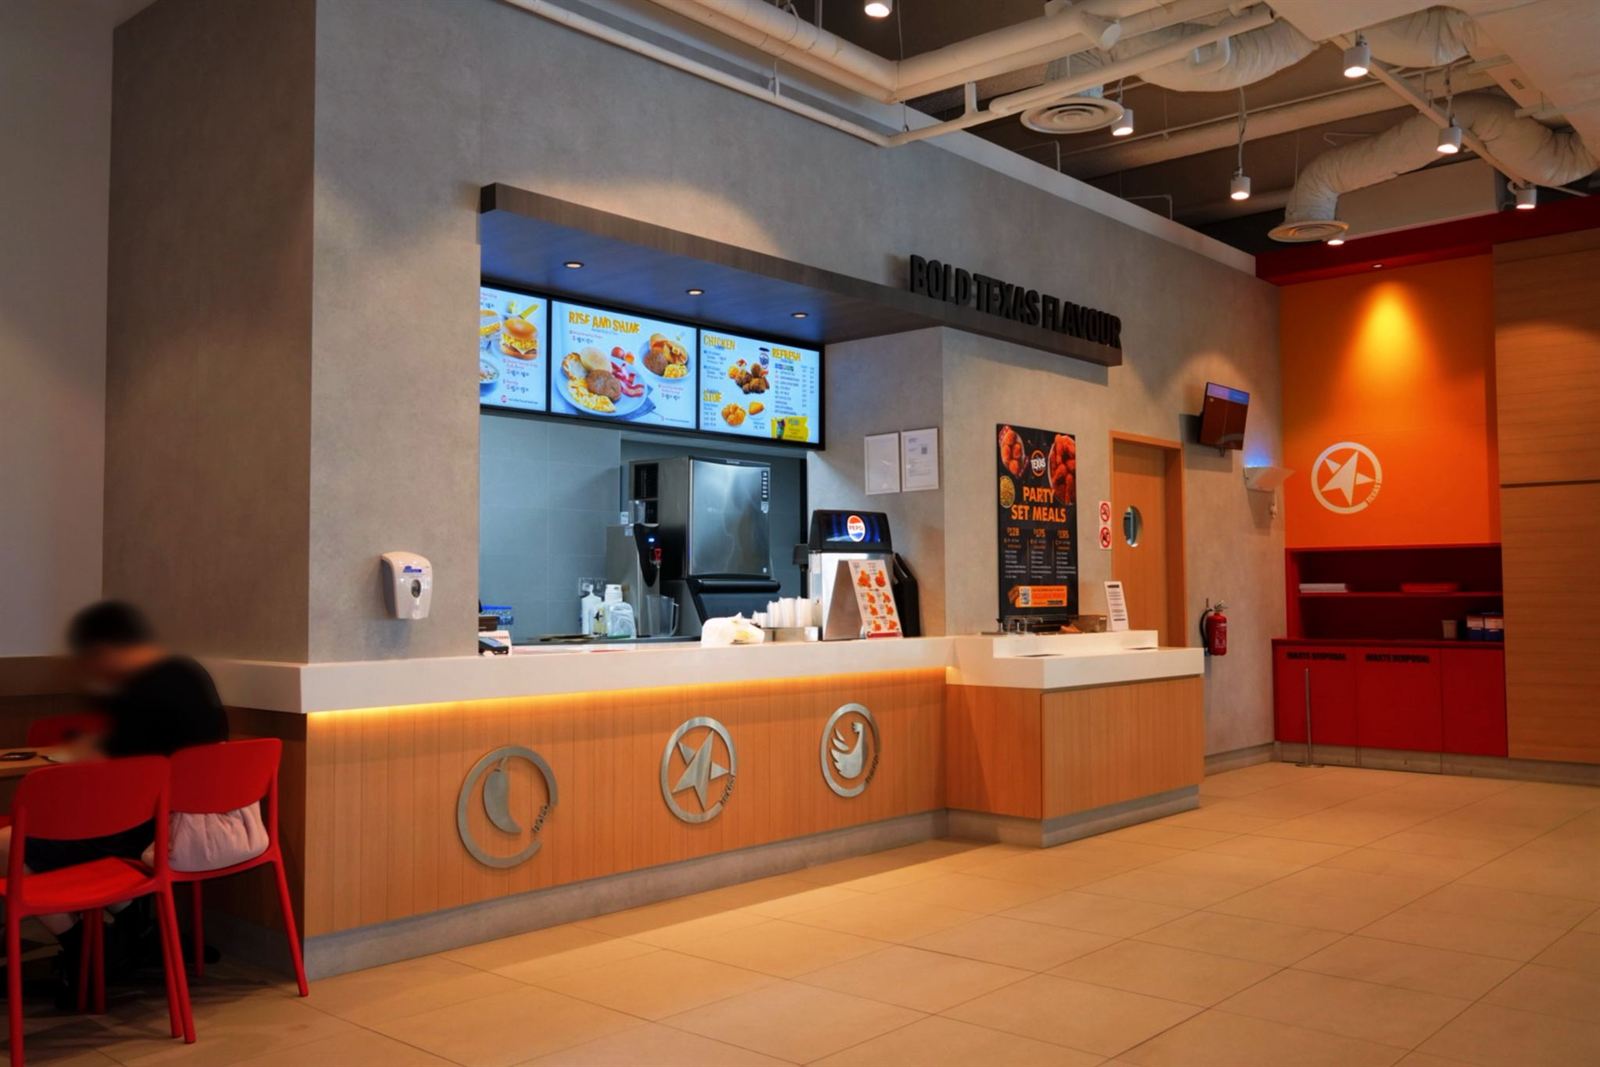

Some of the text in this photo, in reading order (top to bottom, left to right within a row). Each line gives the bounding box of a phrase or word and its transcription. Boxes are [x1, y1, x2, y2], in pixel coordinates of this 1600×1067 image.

[910, 254, 1122, 348] BOLD TEXAS FLAVOUR
[569, 311, 590, 324] RISE
[592, 315, 612, 328] AND
[612, 319, 640, 334] SHINE
[704, 335, 735, 350] CHICKEN
[772, 348, 801, 361] REFRESH
[1030, 457, 1046, 470] TEXAS
[1023, 486, 1055, 503] PARTY
[1011, 504, 1067, 523] SET MEALS
